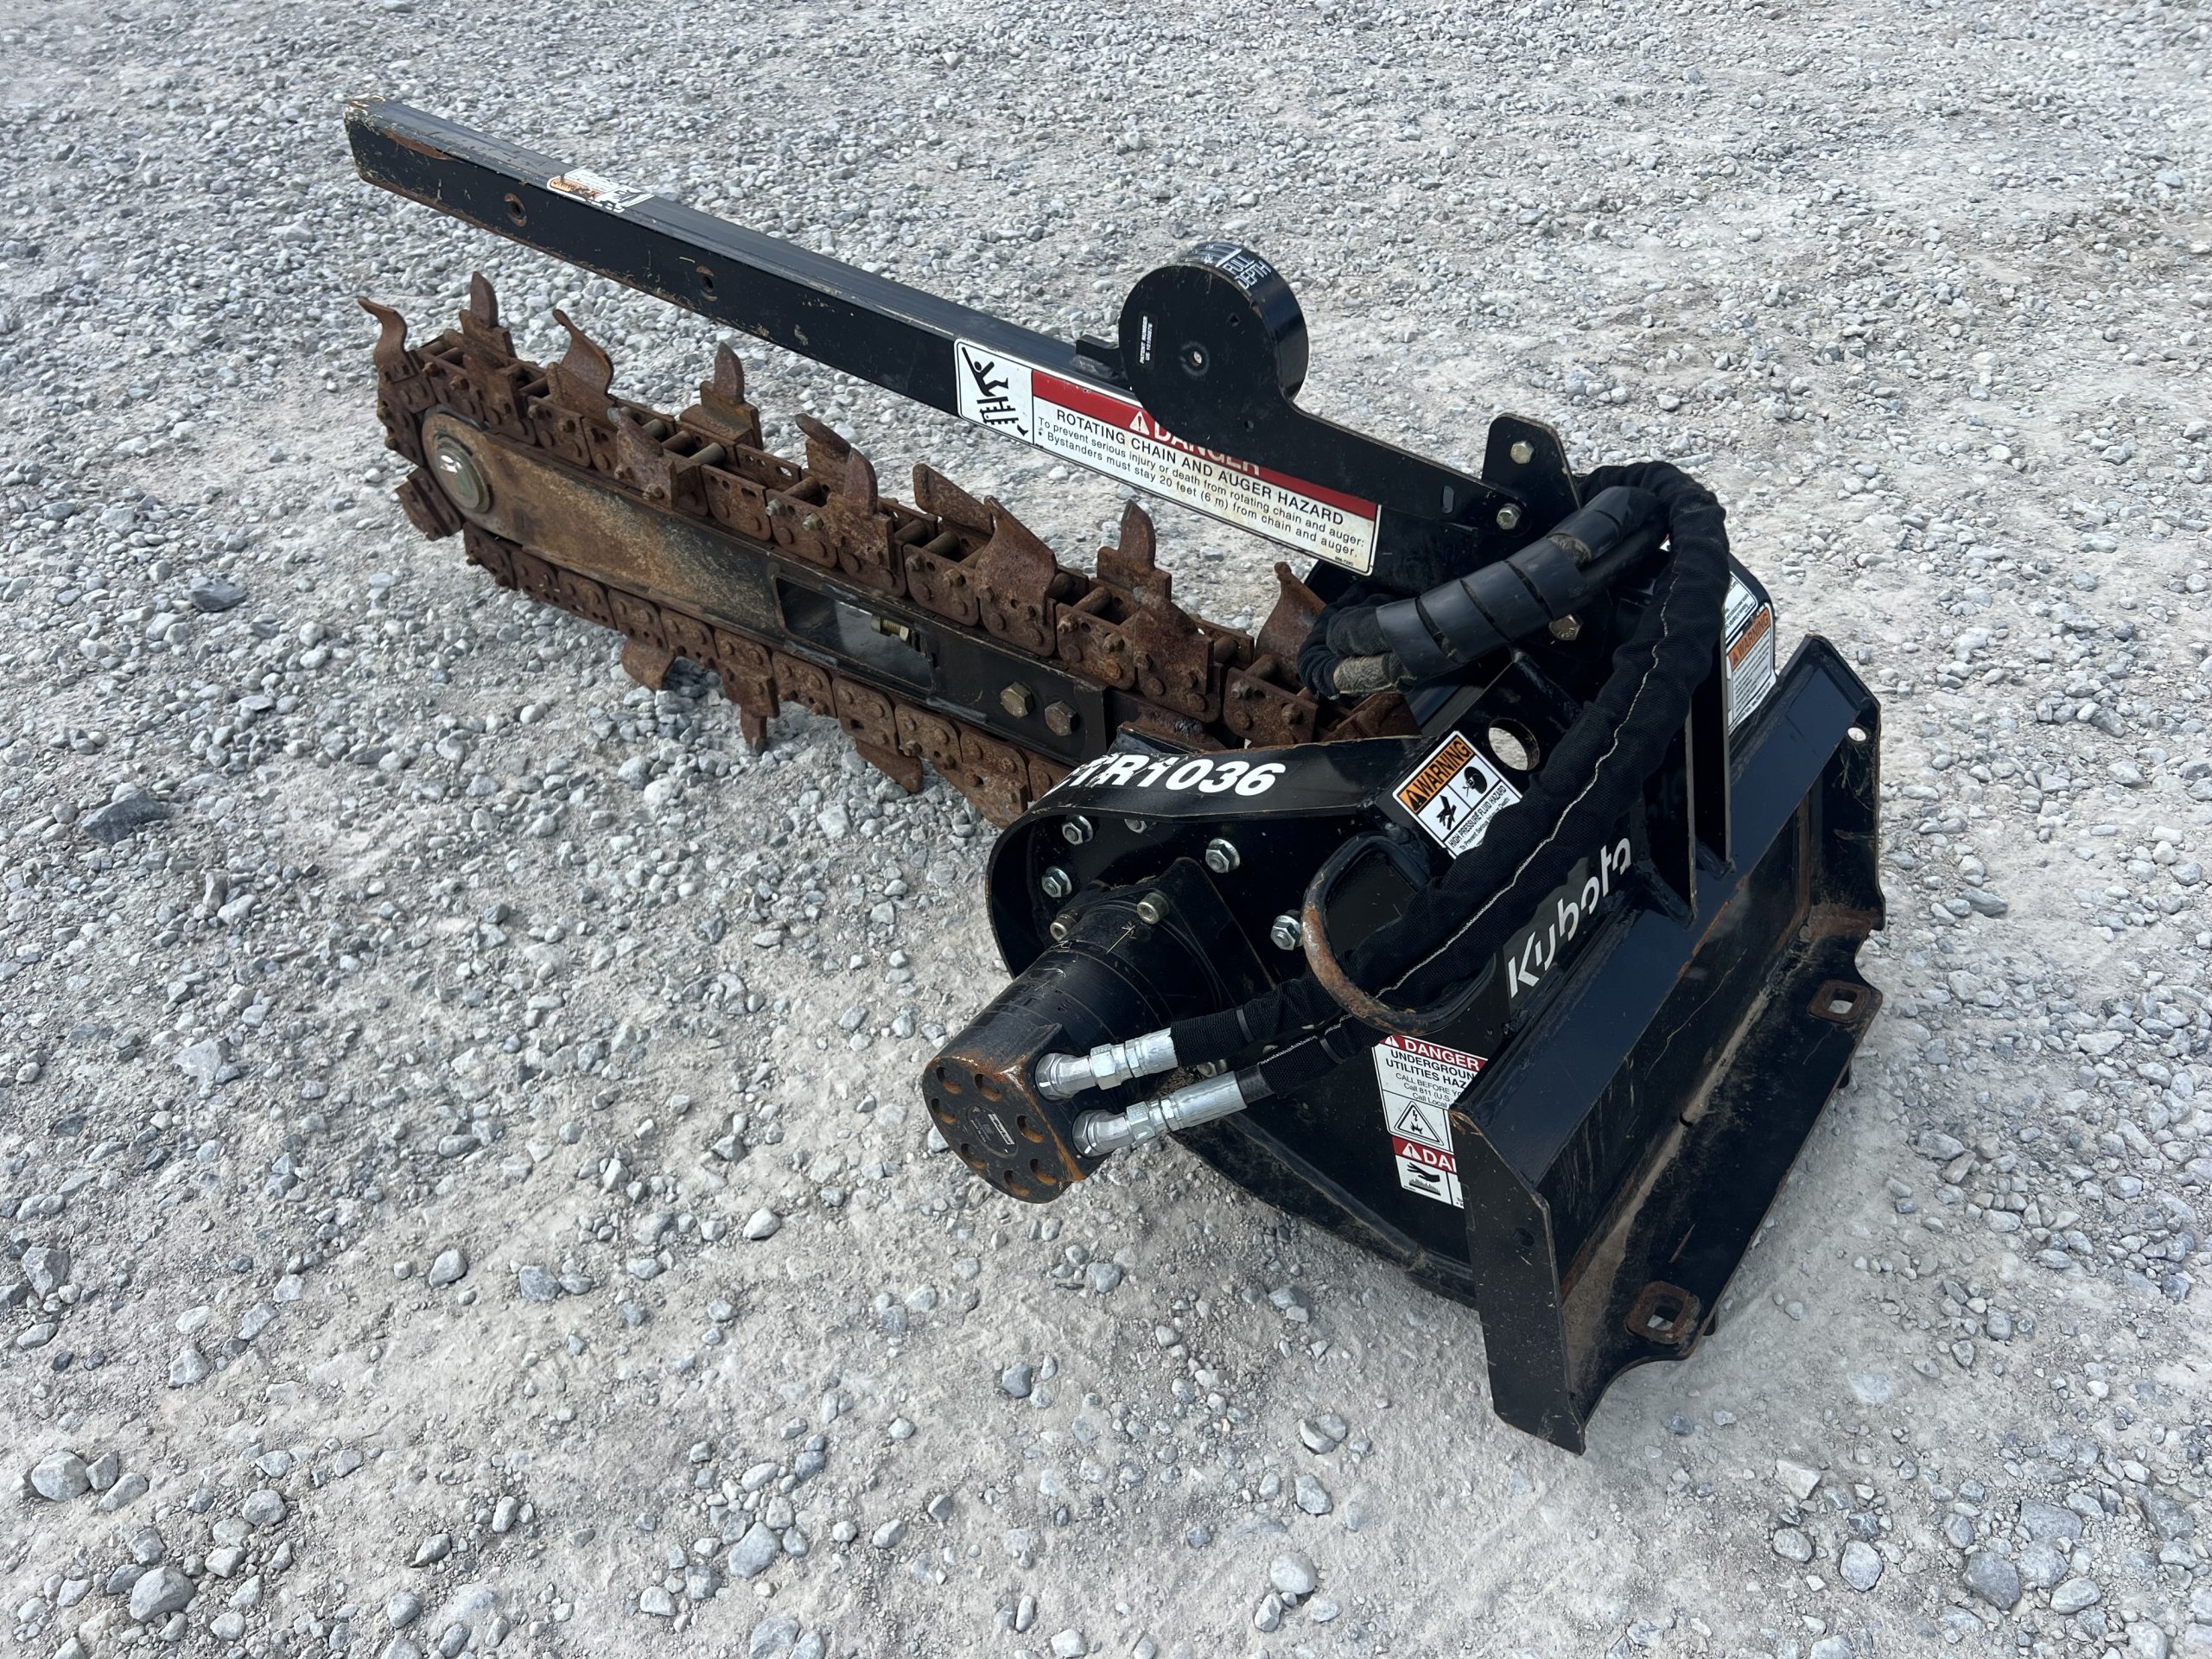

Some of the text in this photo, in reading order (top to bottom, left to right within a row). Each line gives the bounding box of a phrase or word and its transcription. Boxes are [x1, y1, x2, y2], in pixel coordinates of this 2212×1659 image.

[1223, 255, 1255, 275] FULL
[1234, 260, 1271, 289] DEPTH
[1039, 416, 1364, 548] To prevent serious injury or death from rotating chain and auger:
[1057, 409, 1344, 525] ROTATING CHAIN AND AUGER HAZARD
[1047, 432, 1357, 558] Bystanders must stay 20 feet (6 m) from chain and auger.
[1737, 612, 1770, 654] WARNING
[1414, 741, 1471, 798] WARNING
[1447, 835, 1463, 848] HIGH
[1458, 812, 1482, 838] PRESSURE
[1478, 801, 1492, 817] FLUID
[1488, 785, 1507, 804] HAZARD
[1464, 831, 1478, 847] Prevent
[1475, 820, 1489, 834] Serious
[1508, 837, 1631, 998] Kubota
[1386, 1058, 1440, 1082] UTILITIES
[1404, 1039, 1480, 1071] DANGER
[1395, 1072, 1415, 1084] CALL
[1417, 1078, 1450, 1095] BEFORE
[1403, 1083, 1418, 1092] Call
[1419, 1087, 1432, 1096] 811
[1413, 1092, 1427, 1103] Call
[1428, 1097, 1447, 1108] Local
